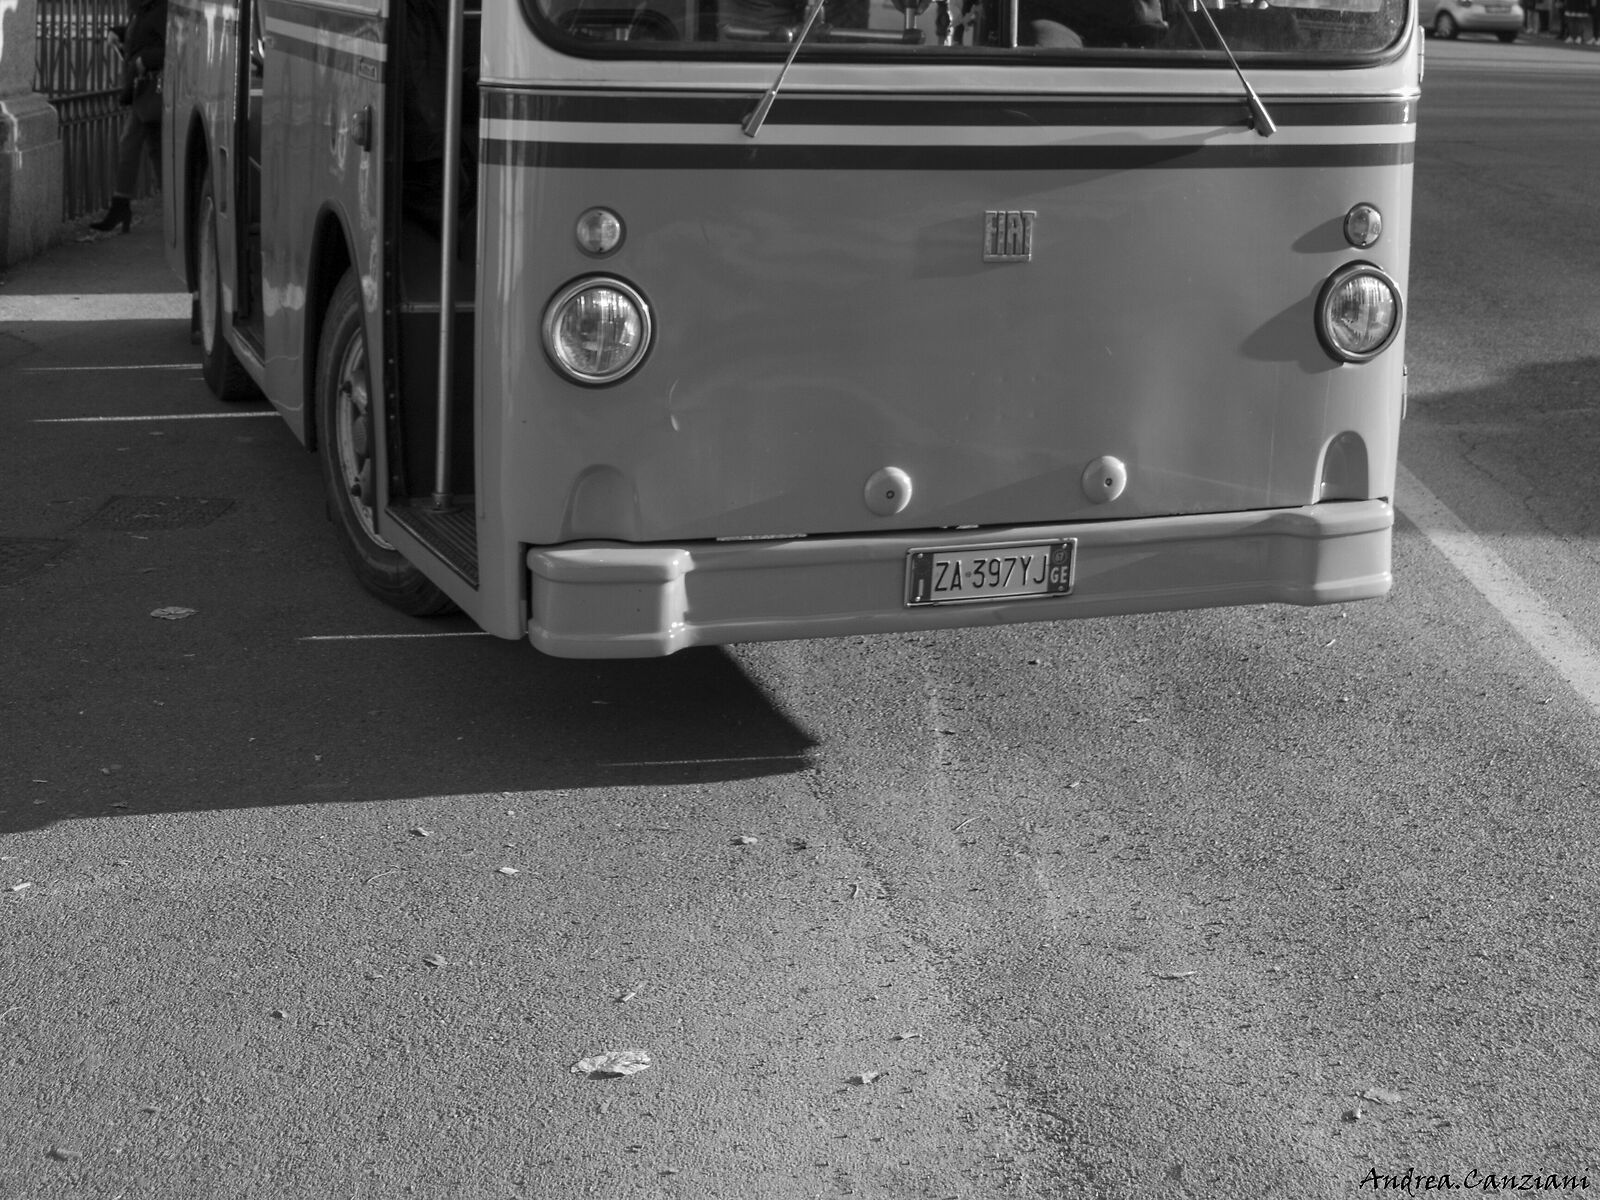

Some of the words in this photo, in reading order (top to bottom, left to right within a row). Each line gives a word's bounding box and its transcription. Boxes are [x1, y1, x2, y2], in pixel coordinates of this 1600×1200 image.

[984, 210, 1037, 261] FIAT
[934, 561, 961, 591] ZA
[972, 554, 1048, 588] 397YJ
[1050, 566, 1068, 584] GE
